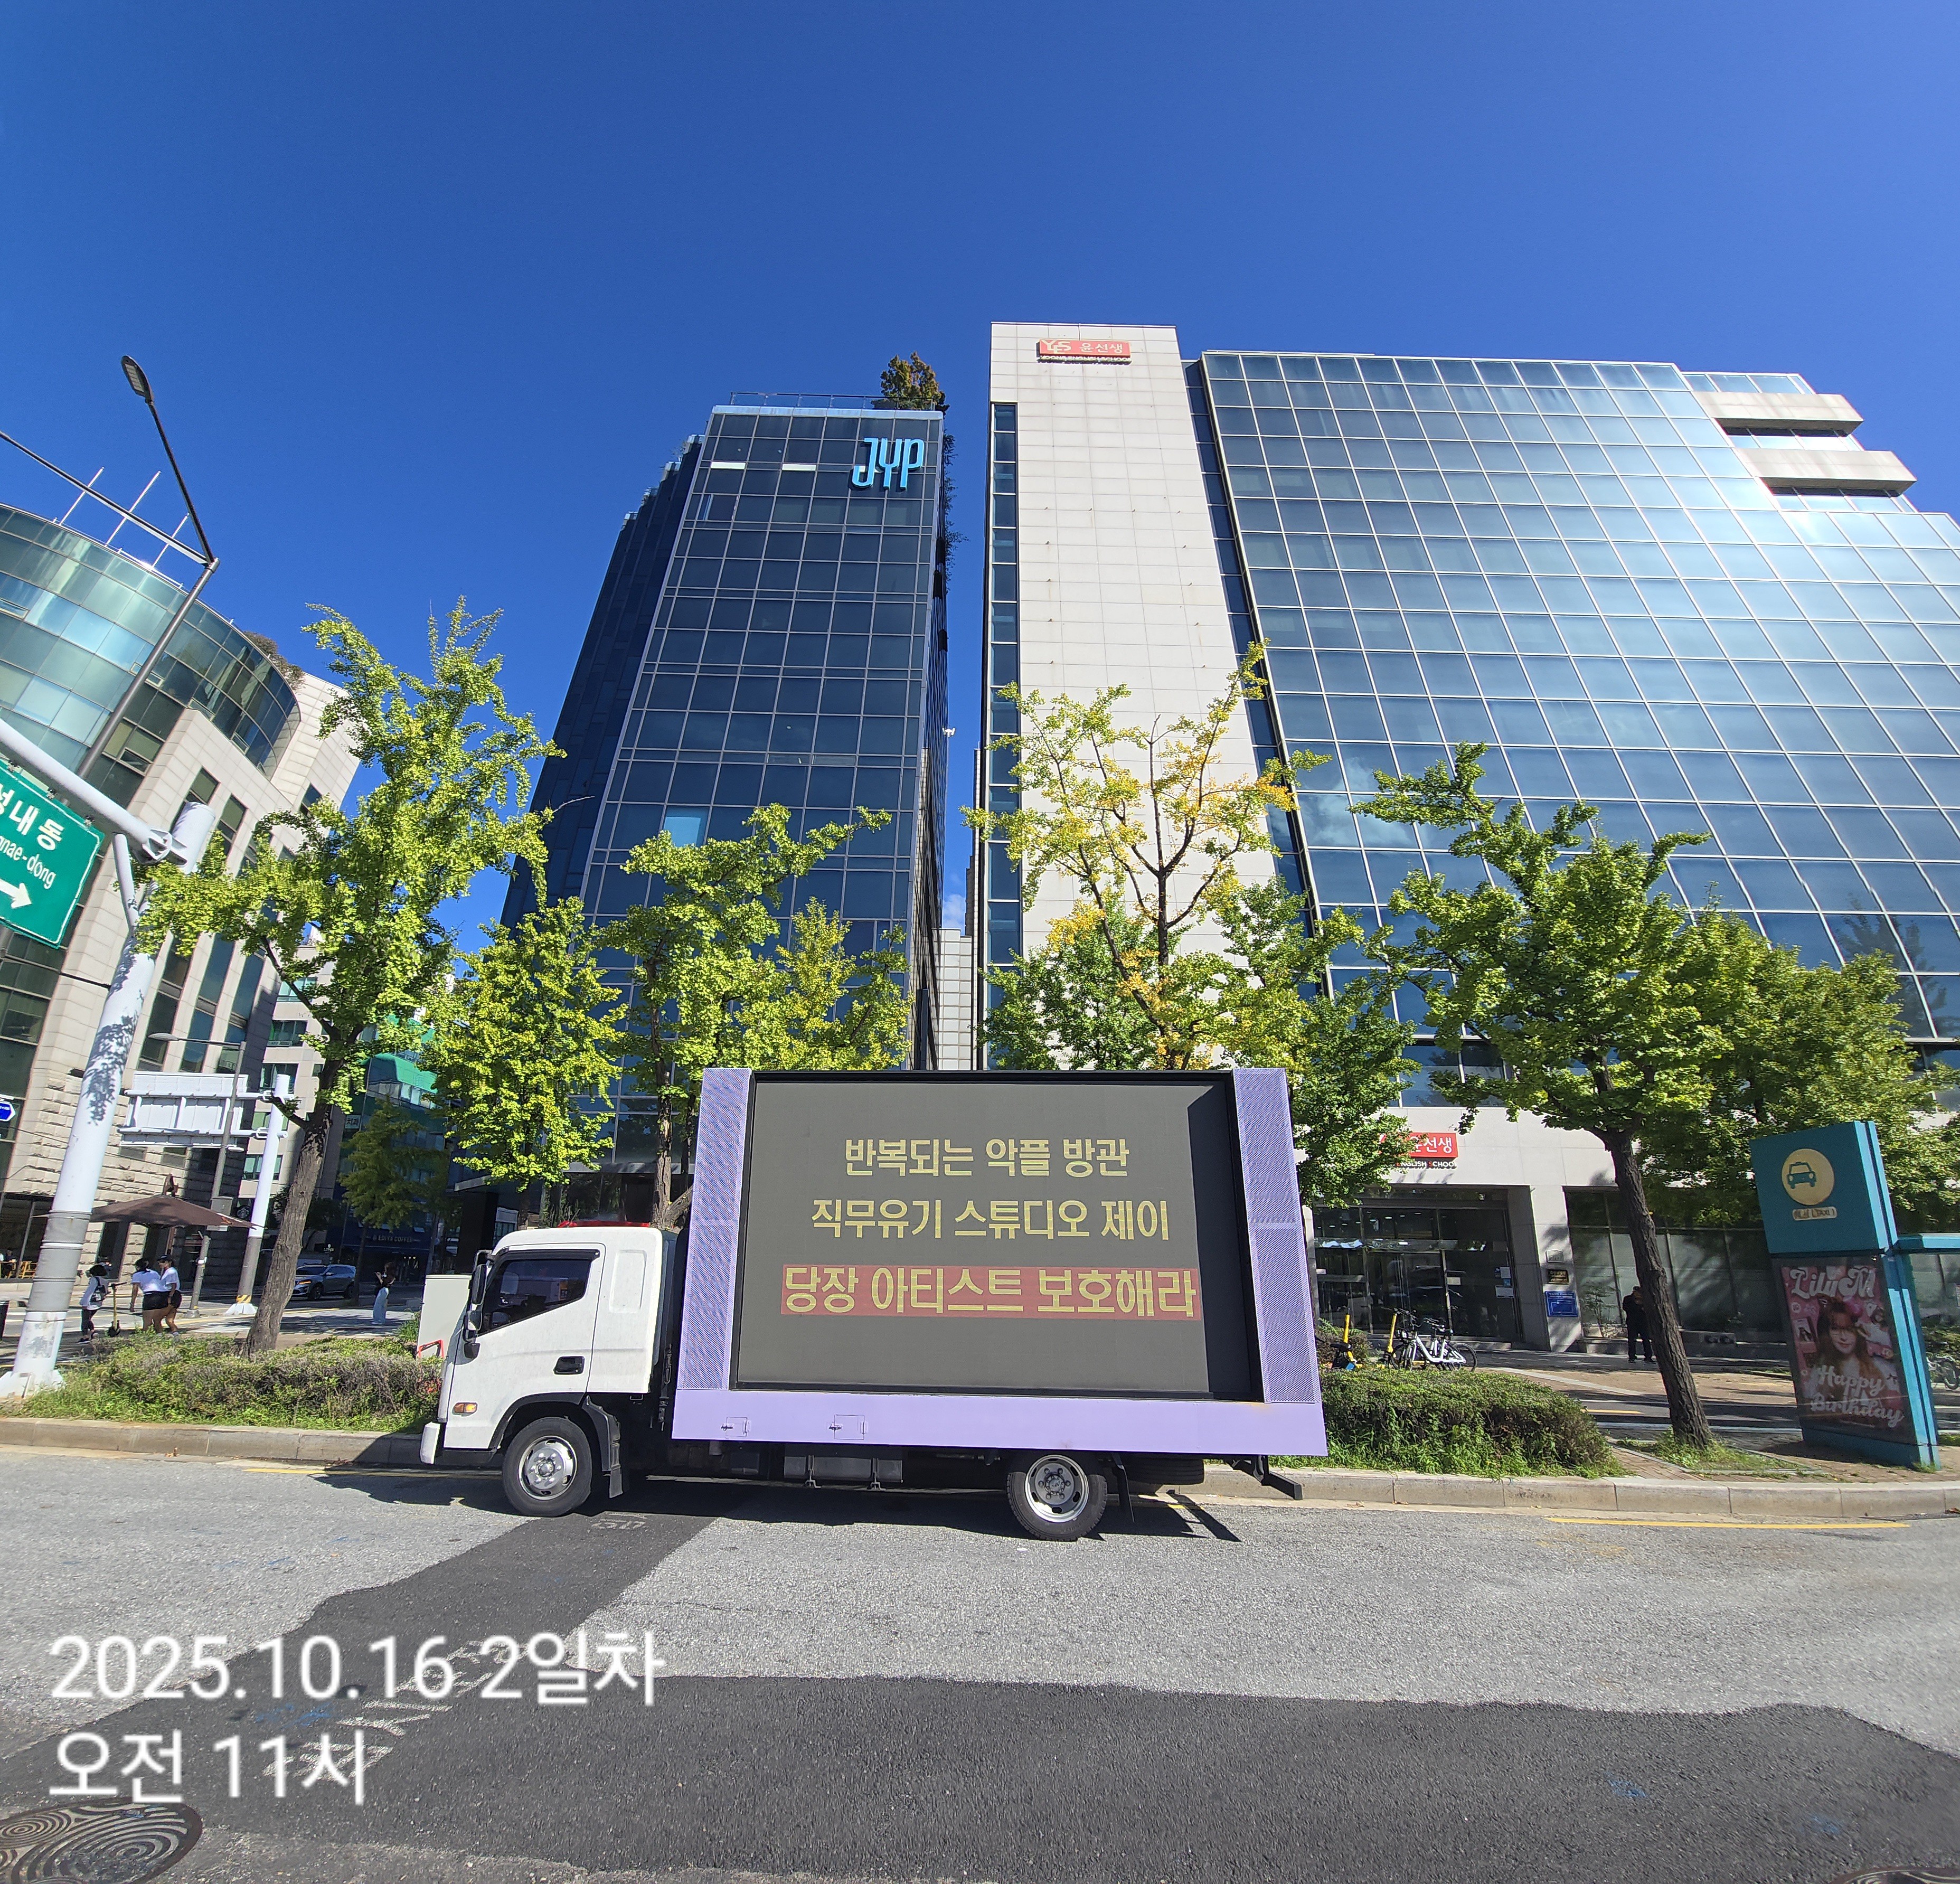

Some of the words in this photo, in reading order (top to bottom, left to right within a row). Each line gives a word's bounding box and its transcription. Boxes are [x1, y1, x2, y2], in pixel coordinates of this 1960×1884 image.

[1079, 343, 1123, 354] 윤선생
[852, 438, 924, 490] JYP
[845, 1138, 974, 1176] 반복되는
[986, 1139, 1050, 1176] 악플
[1063, 1139, 1130, 1178] 방관
[811, 1199, 942, 1239] 직무유기
[954, 1200, 1090, 1239] 스튜디오
[1101, 1200, 1169, 1240] 제이
[785, 1265, 859, 1314] 당장
[871, 1266, 1024, 1314] 아티스트
[1037, 1267, 1197, 1317] 보호해라
[1816, 1364, 1885, 1397] Happy
[1811, 1391, 1904, 1428] Birthday
